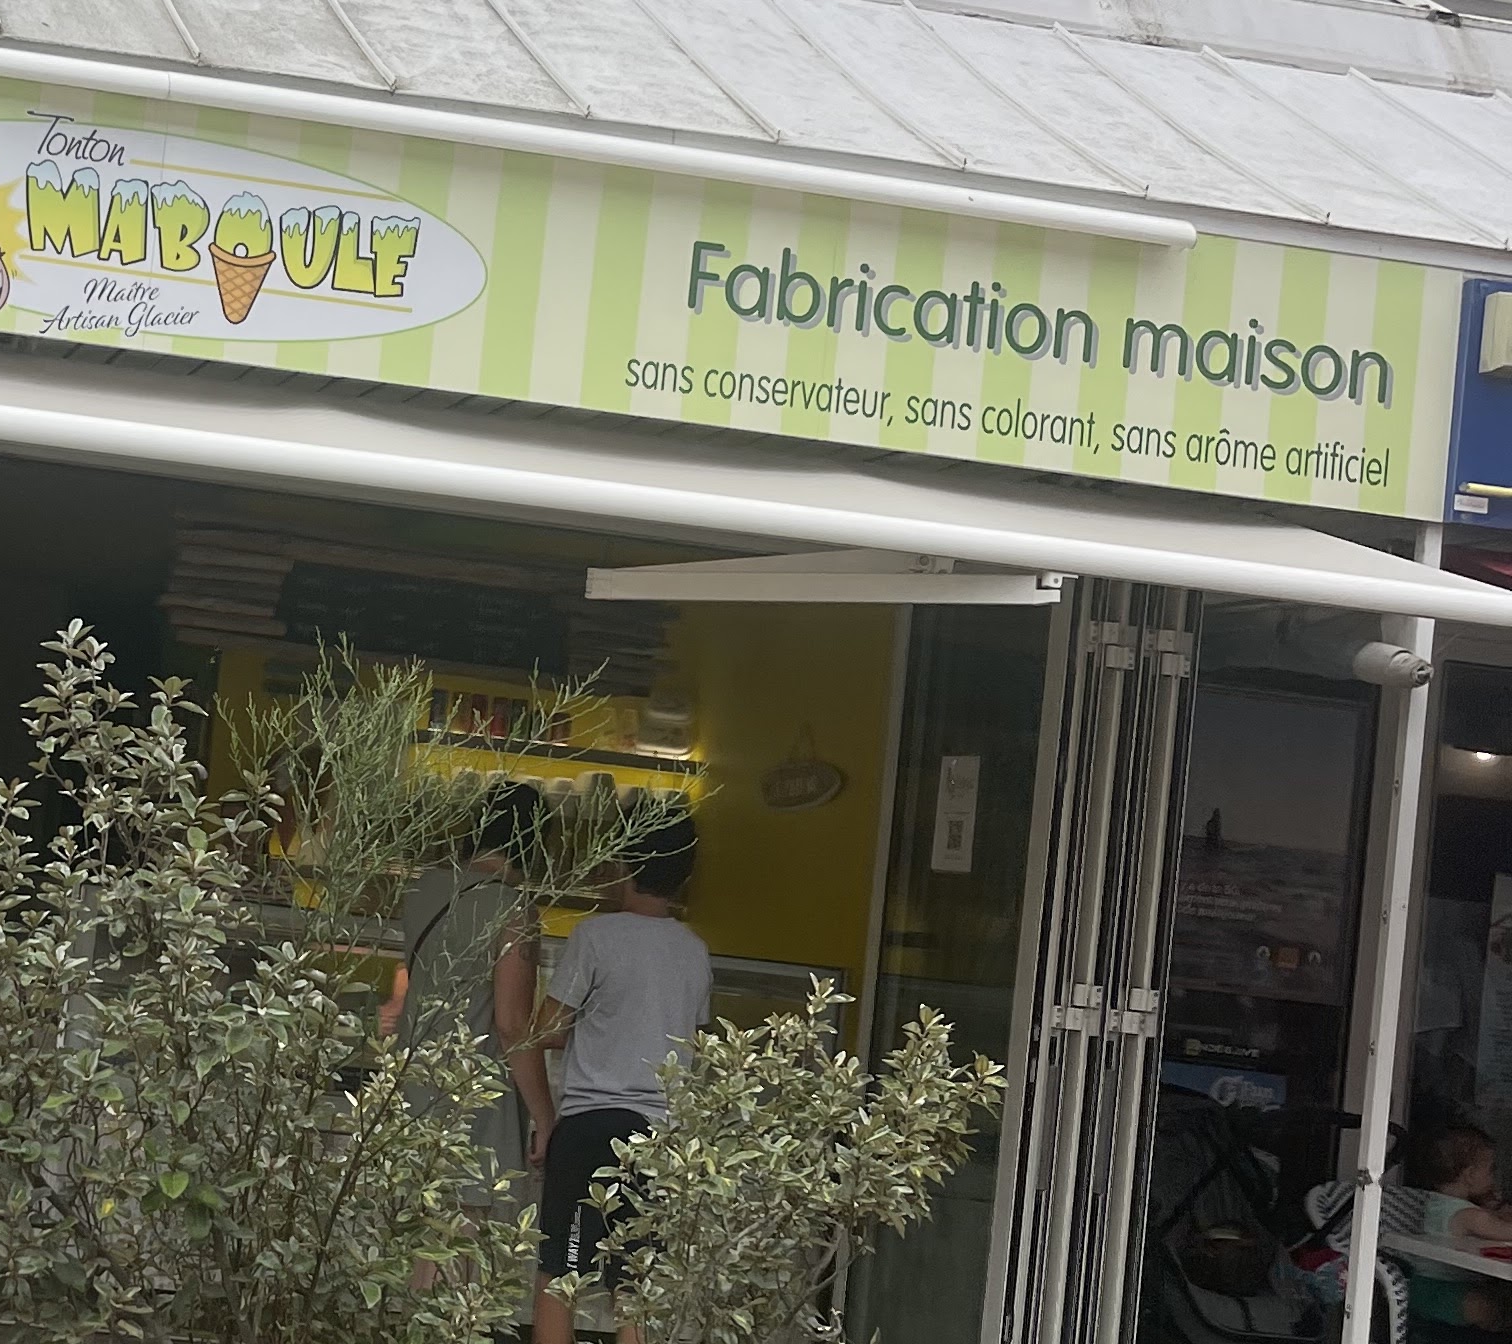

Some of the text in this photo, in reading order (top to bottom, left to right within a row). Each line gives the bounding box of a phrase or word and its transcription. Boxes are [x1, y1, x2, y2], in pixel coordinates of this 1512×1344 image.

[27, 110, 125, 167] Tonton
[25, 158, 421, 324] MABOULE
[39, 301, 201, 338] Artisan Glacier
[83, 277, 161, 304] Maître
[687, 240, 1394, 408] Fabrication maison
[625, 355, 1390, 489] sans conservateur, sans colorant, sans arôme artificiel
